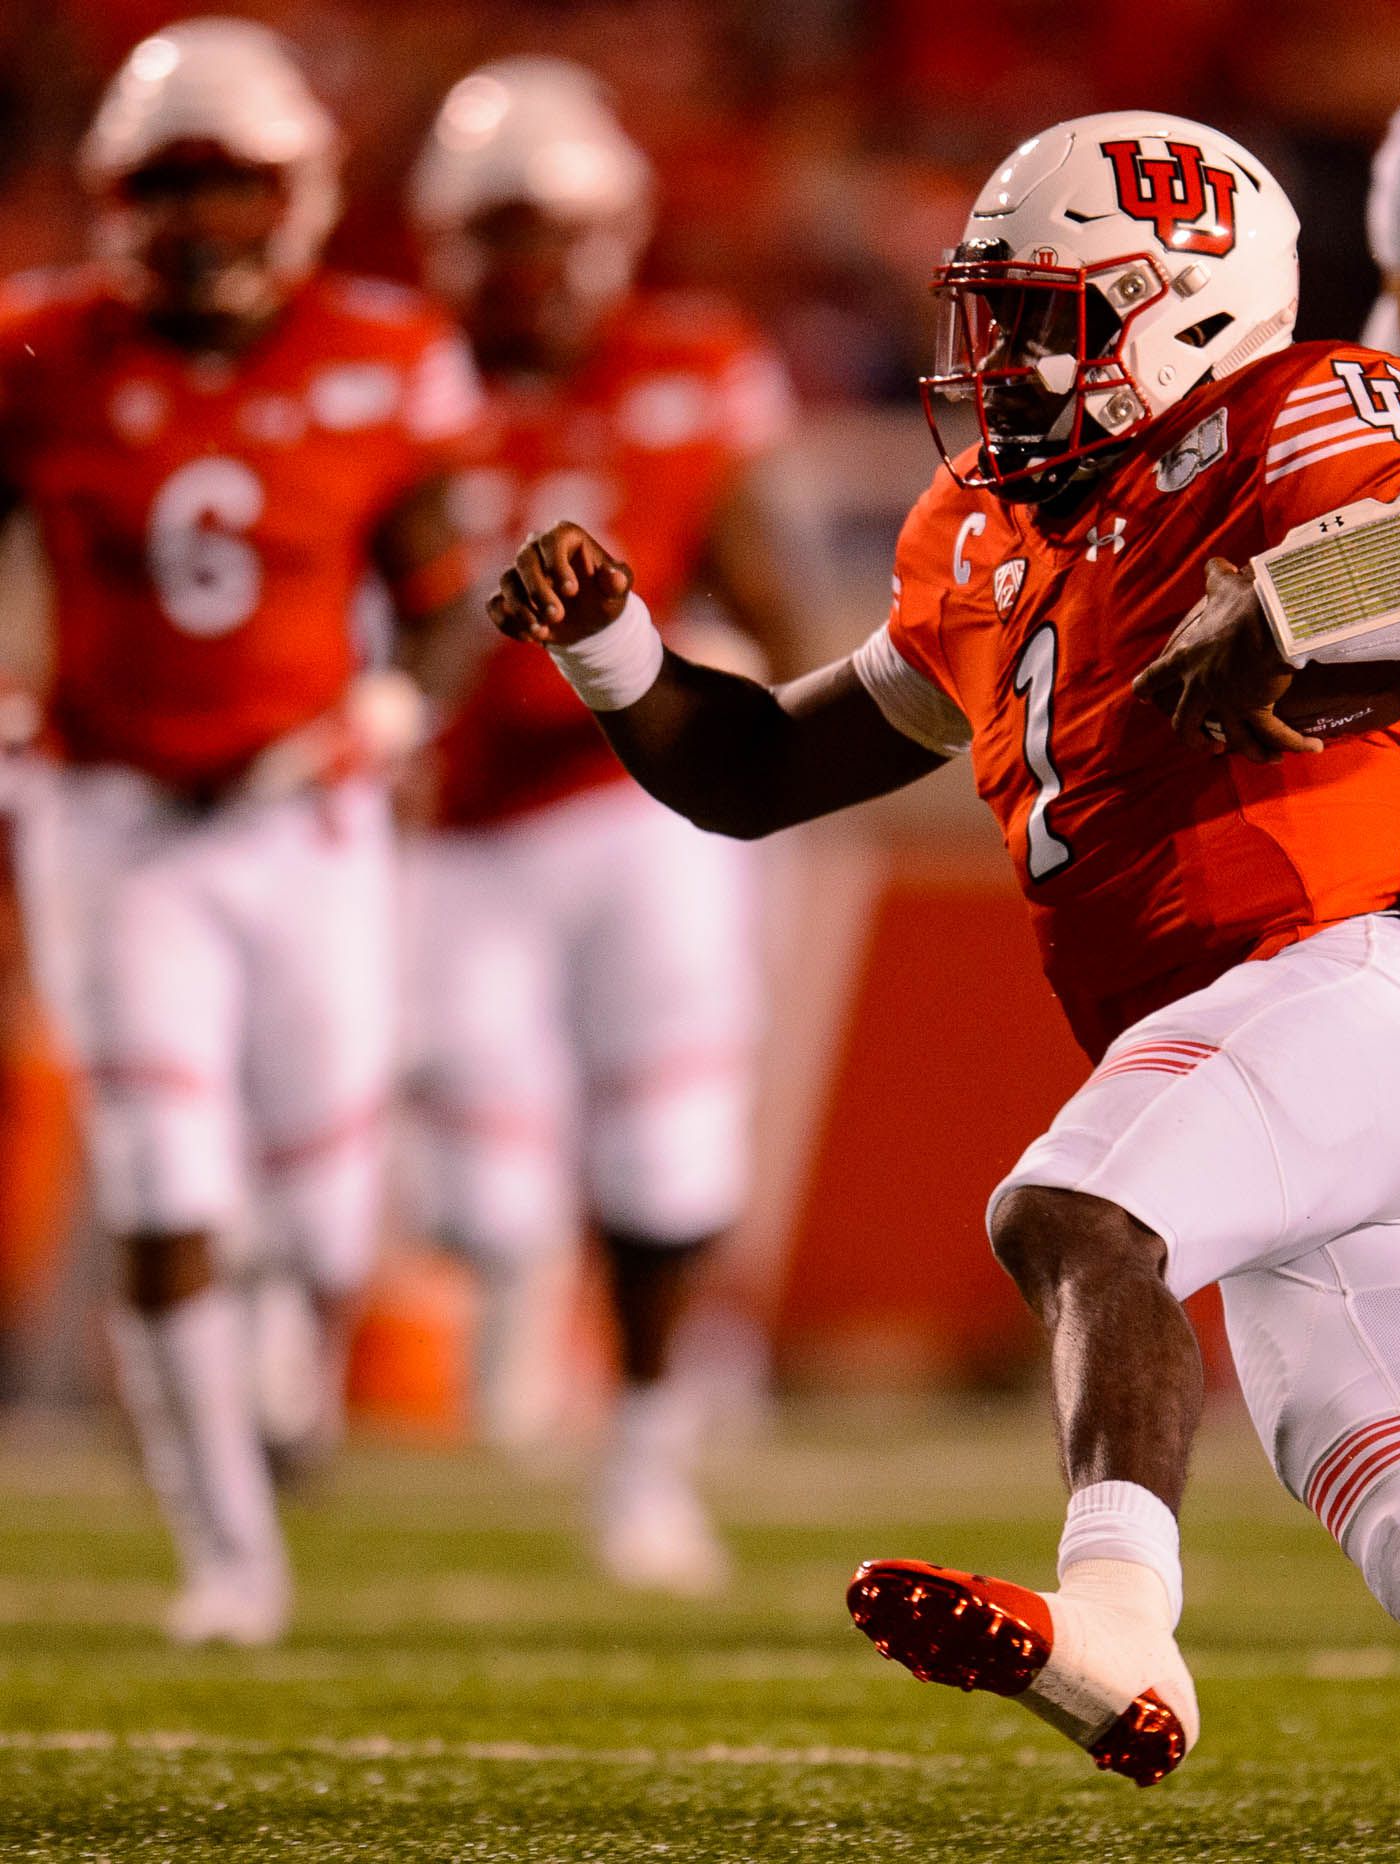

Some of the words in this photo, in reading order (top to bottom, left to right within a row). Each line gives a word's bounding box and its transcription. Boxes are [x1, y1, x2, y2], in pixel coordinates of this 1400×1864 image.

[149, 458, 266, 640] 6
[953, 511, 987, 585] C
[1014, 621, 1074, 885] 1
[1330, 707, 1375, 729] TEAM
